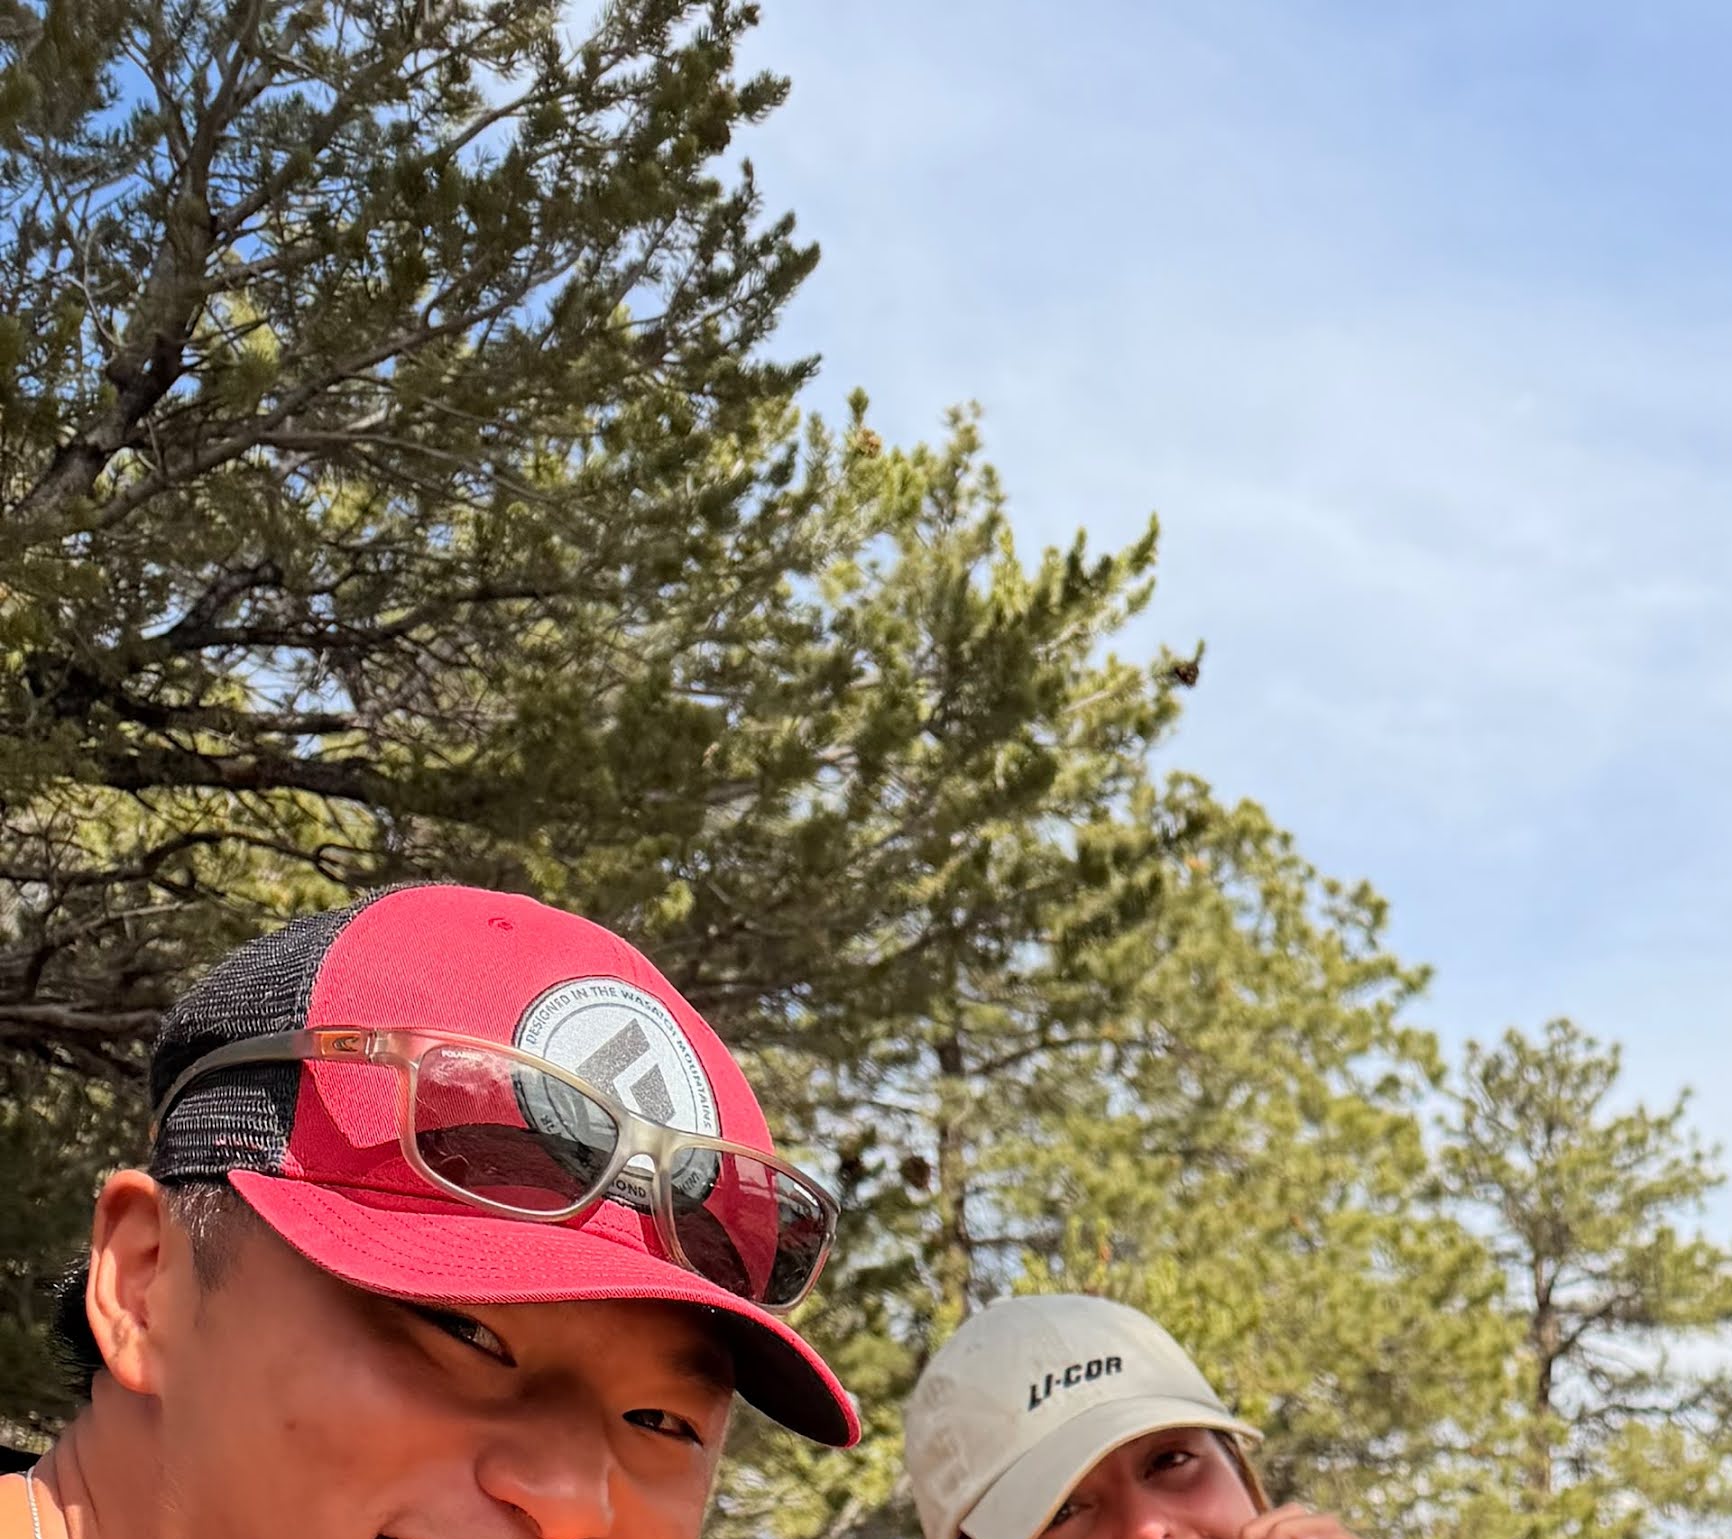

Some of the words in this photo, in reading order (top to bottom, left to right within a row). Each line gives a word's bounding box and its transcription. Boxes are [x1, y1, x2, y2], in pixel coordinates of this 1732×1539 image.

[525, 993, 571, 1045] DESIGNED
[570, 987, 589, 1000] IN
[589, 985, 617, 997] THE
[1027, 1355, 1123, 1412] LI-COR
